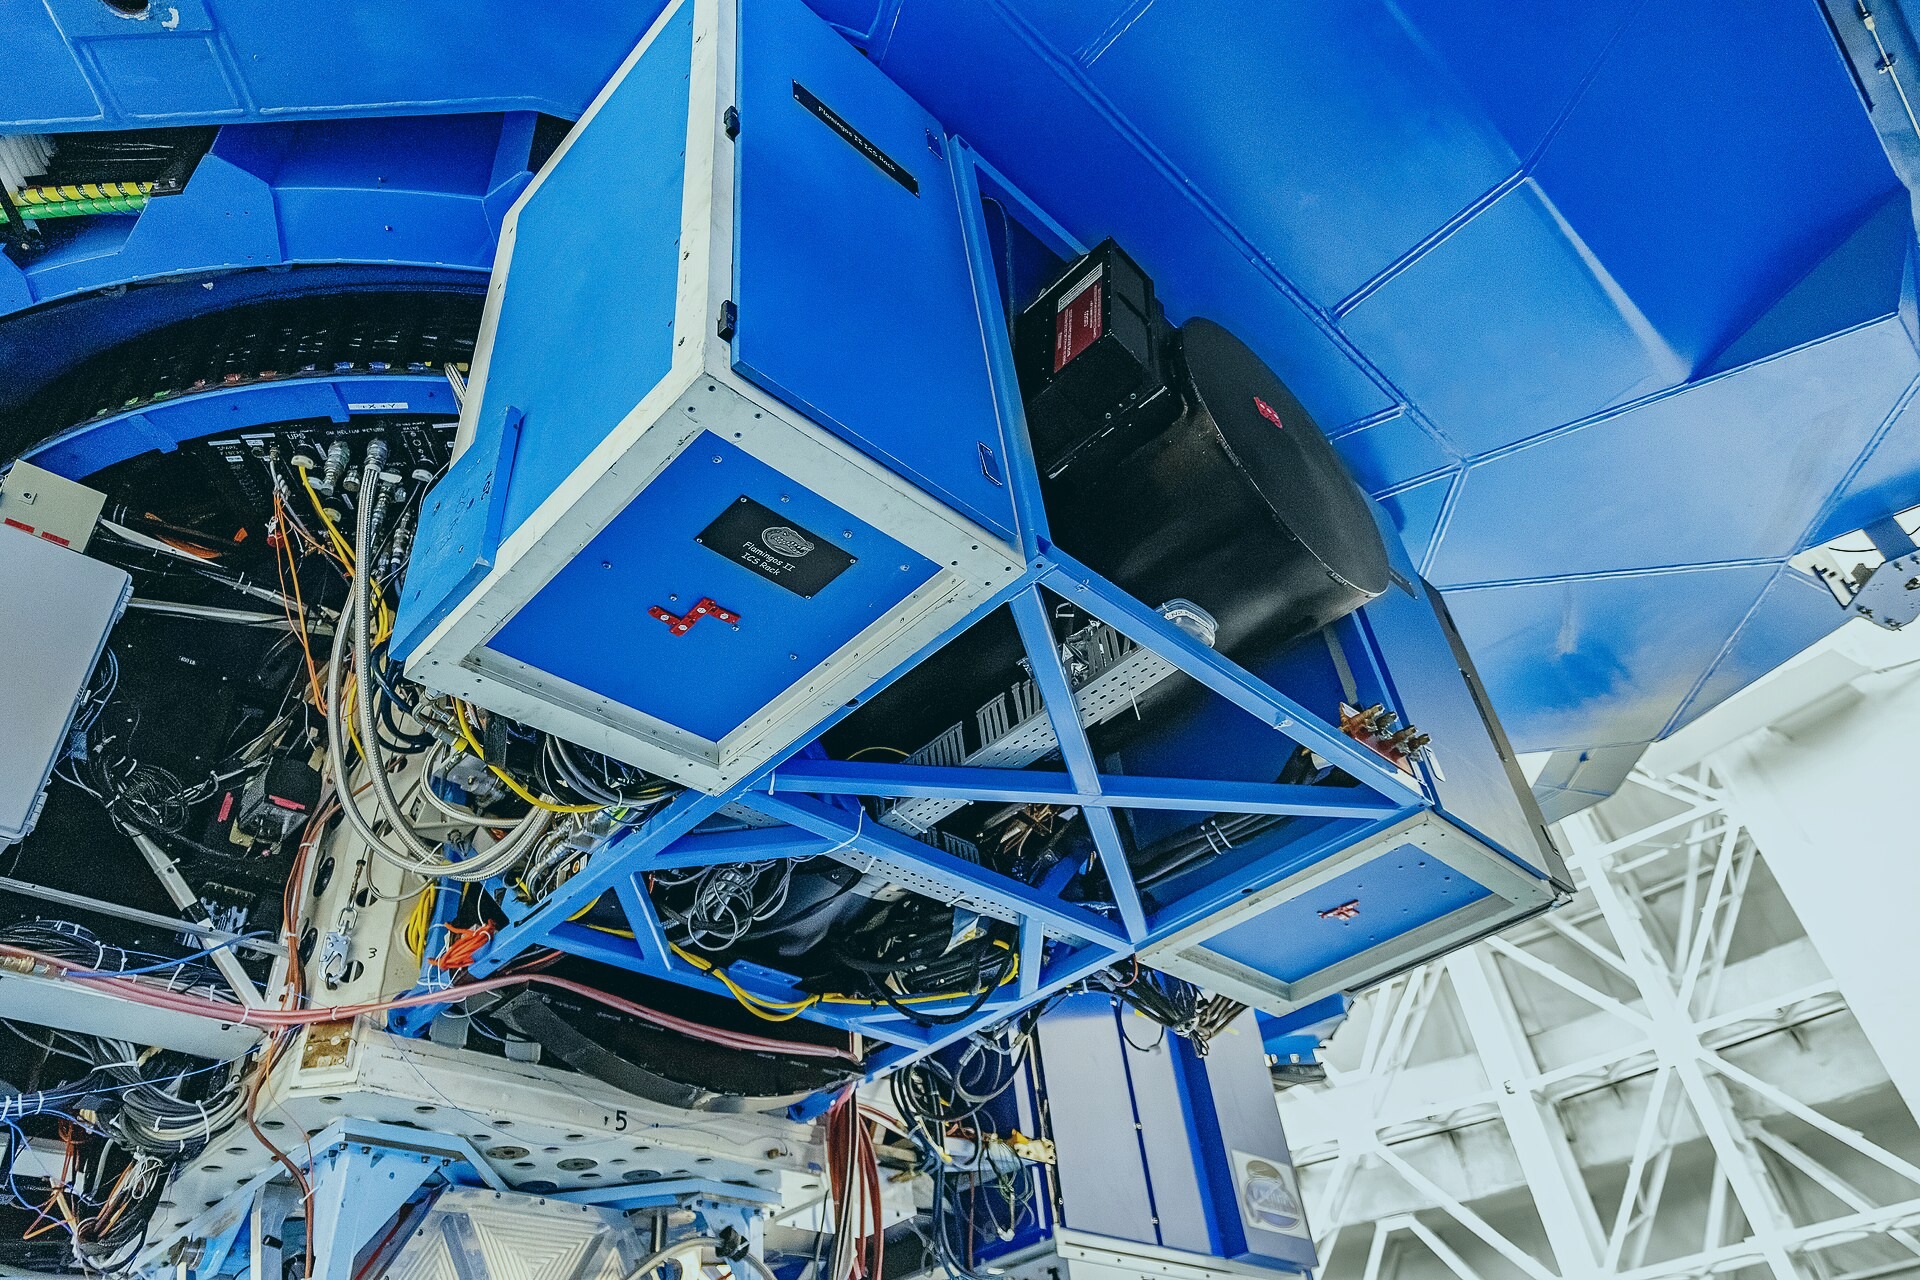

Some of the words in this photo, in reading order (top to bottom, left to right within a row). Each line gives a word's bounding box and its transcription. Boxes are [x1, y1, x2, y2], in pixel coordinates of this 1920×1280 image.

[818, 105, 853, 137] Flamingos
[864, 142, 878, 157] ICS
[337, 428, 360, 436] HELIUM
[741, 552, 759, 565] ICS
[759, 562, 781, 576] Rack
[742, 541, 784, 567] Flamingos
[782, 562, 796, 572] II
[368, 947, 378, 959] 3
[615, 1109, 628, 1132] 5
